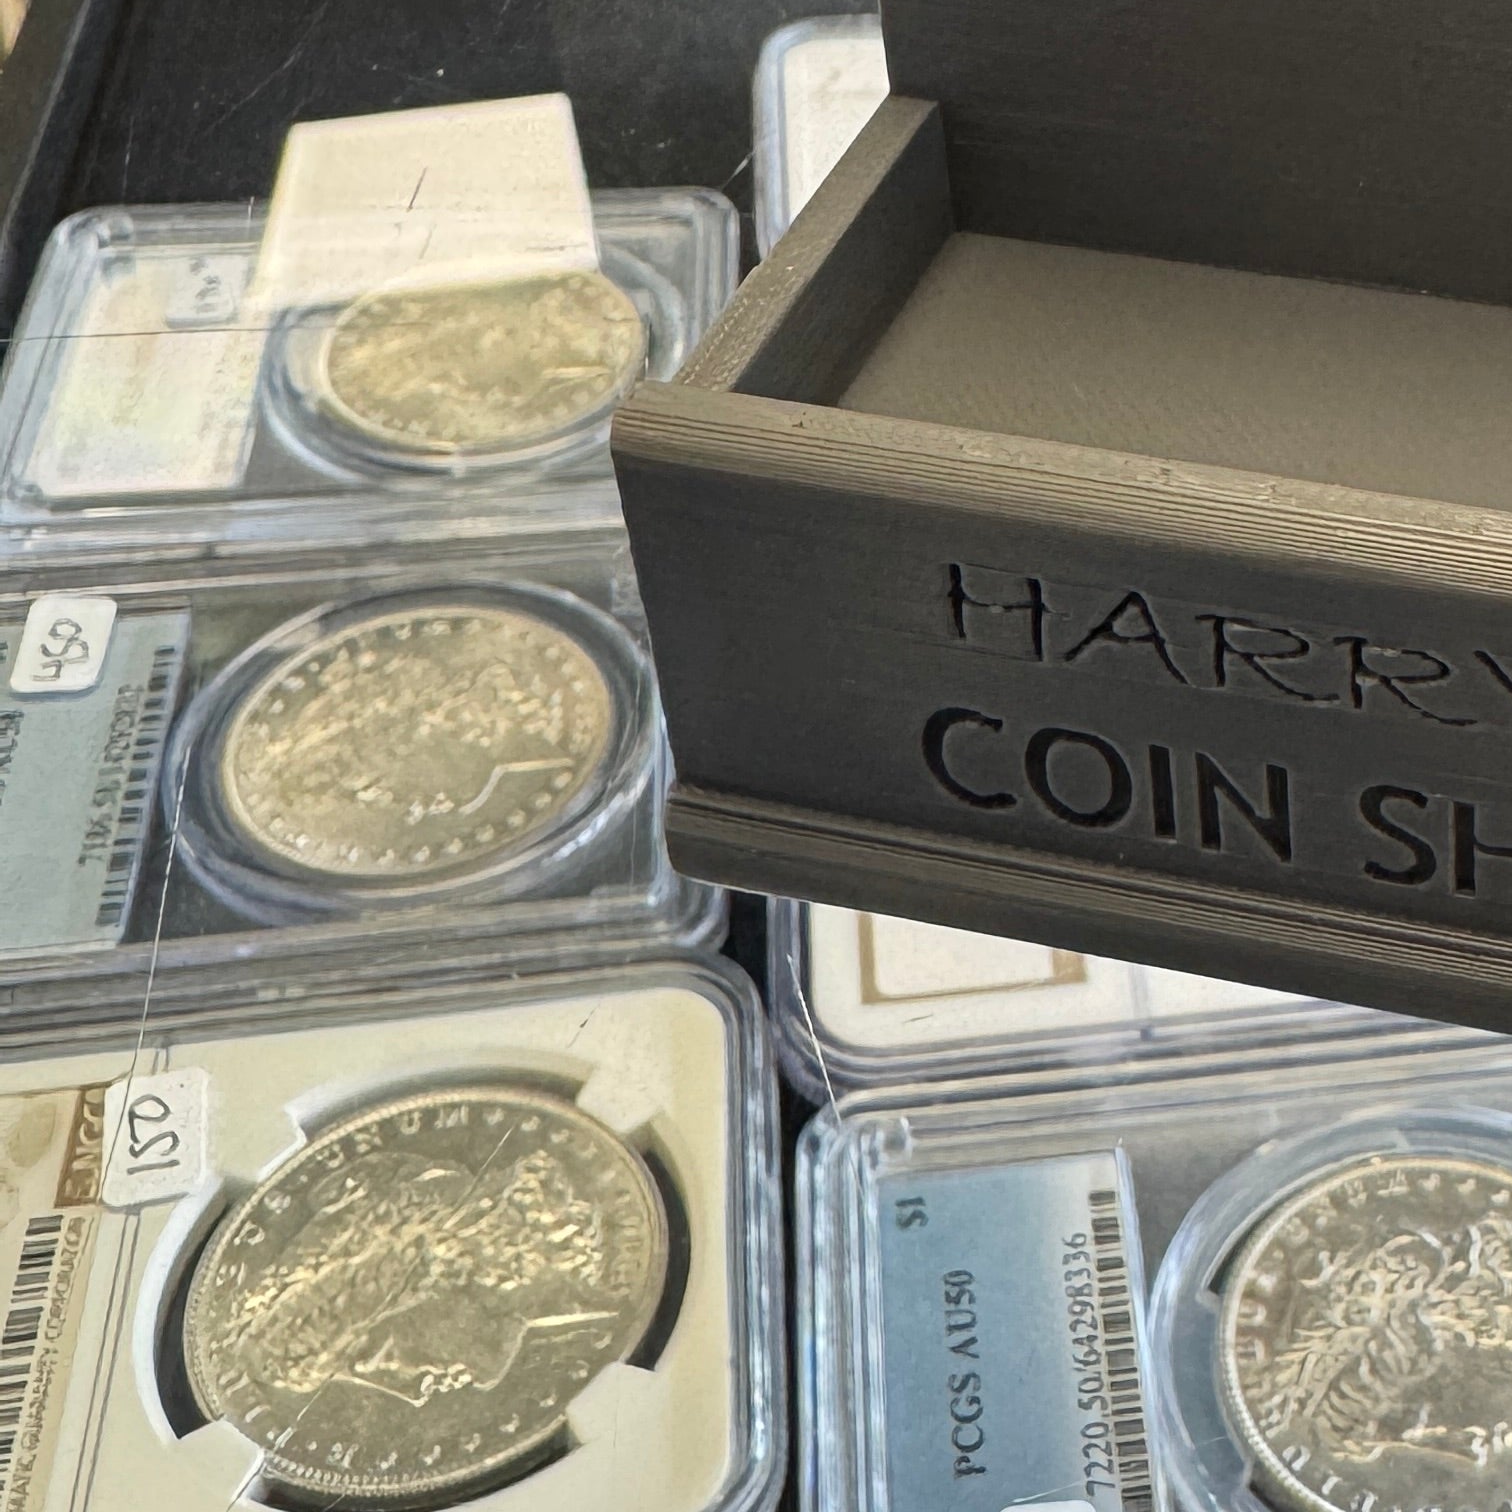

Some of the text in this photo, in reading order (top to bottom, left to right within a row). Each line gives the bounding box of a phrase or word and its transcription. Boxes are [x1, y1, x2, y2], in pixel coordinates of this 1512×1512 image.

[920, 706, 1292, 863] COIN
[126, 1092, 180, 1176] 150
[940, 1268, 986, 1480] PCGS AU50
